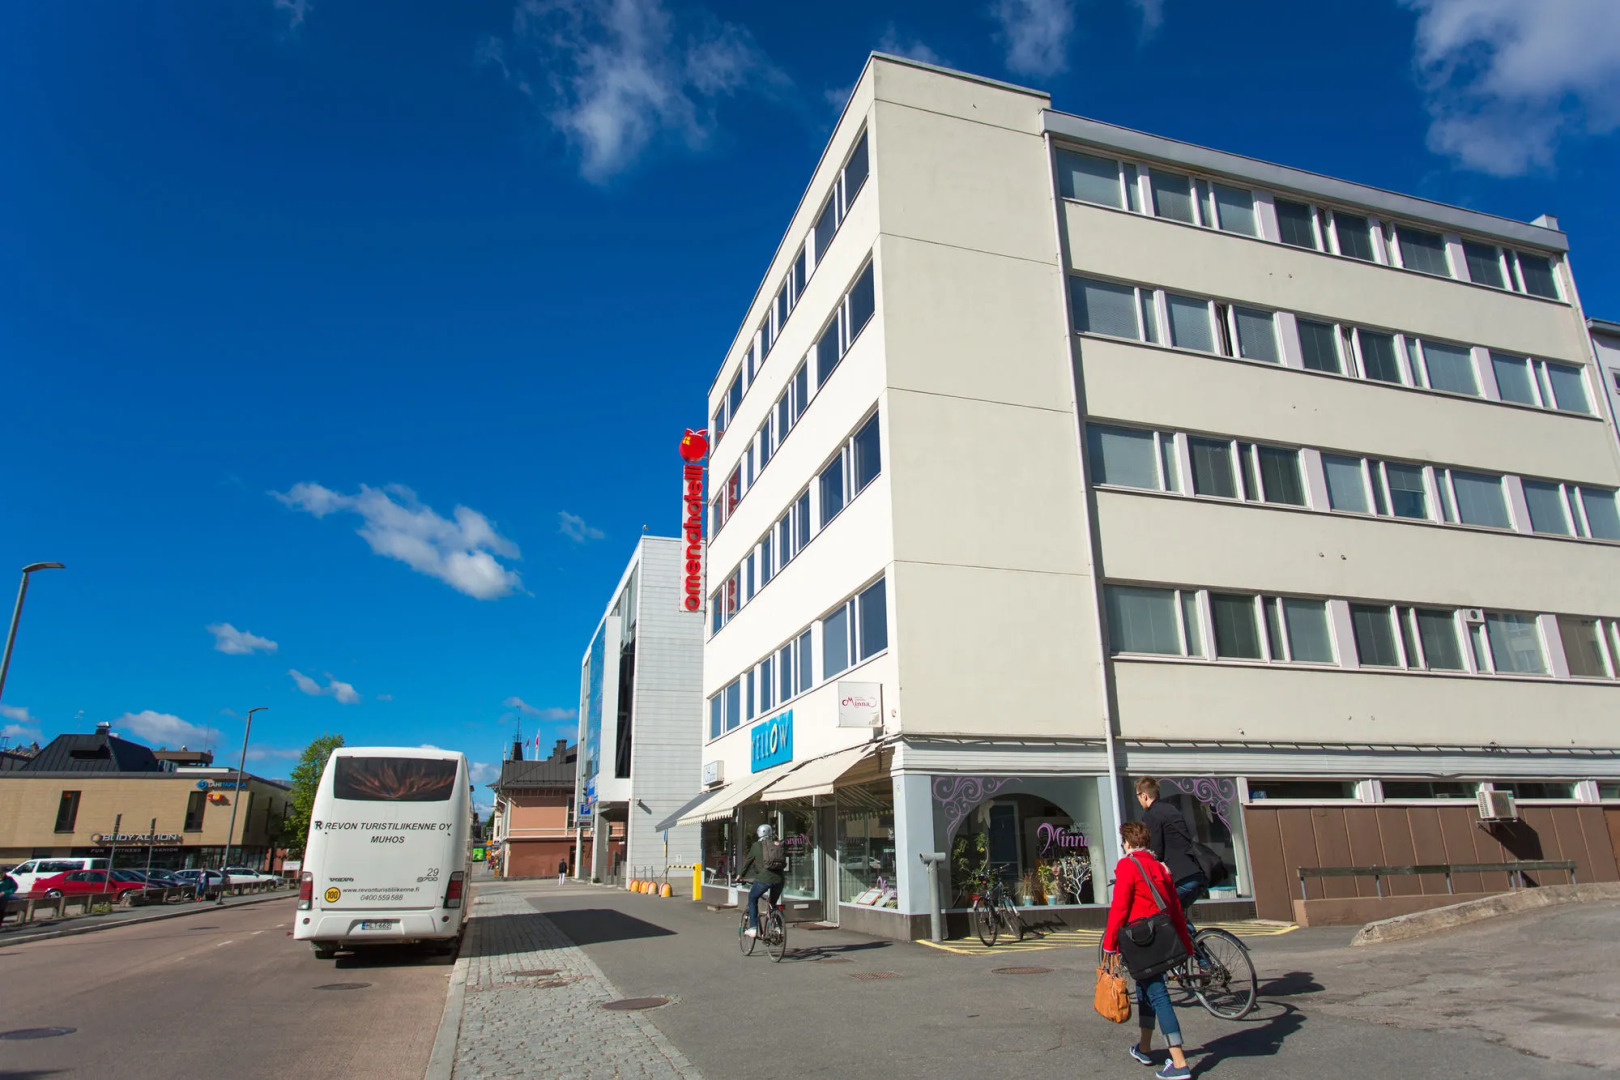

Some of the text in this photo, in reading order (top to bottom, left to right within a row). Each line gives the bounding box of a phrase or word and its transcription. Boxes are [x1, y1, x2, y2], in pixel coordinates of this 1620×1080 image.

[683, 464, 704, 611] omenahotelli
[751, 723, 790, 761] YELLOW
[325, 822, 358, 830] REVON
[360, 822, 437, 831] TURISTILIIKENNE
[438, 823, 453, 831] OY
[370, 836, 405, 844] MUHOS
[1037, 822, 1093, 856] Minna
[426, 867, 440, 877] 29
[327, 890, 339, 900] 100
